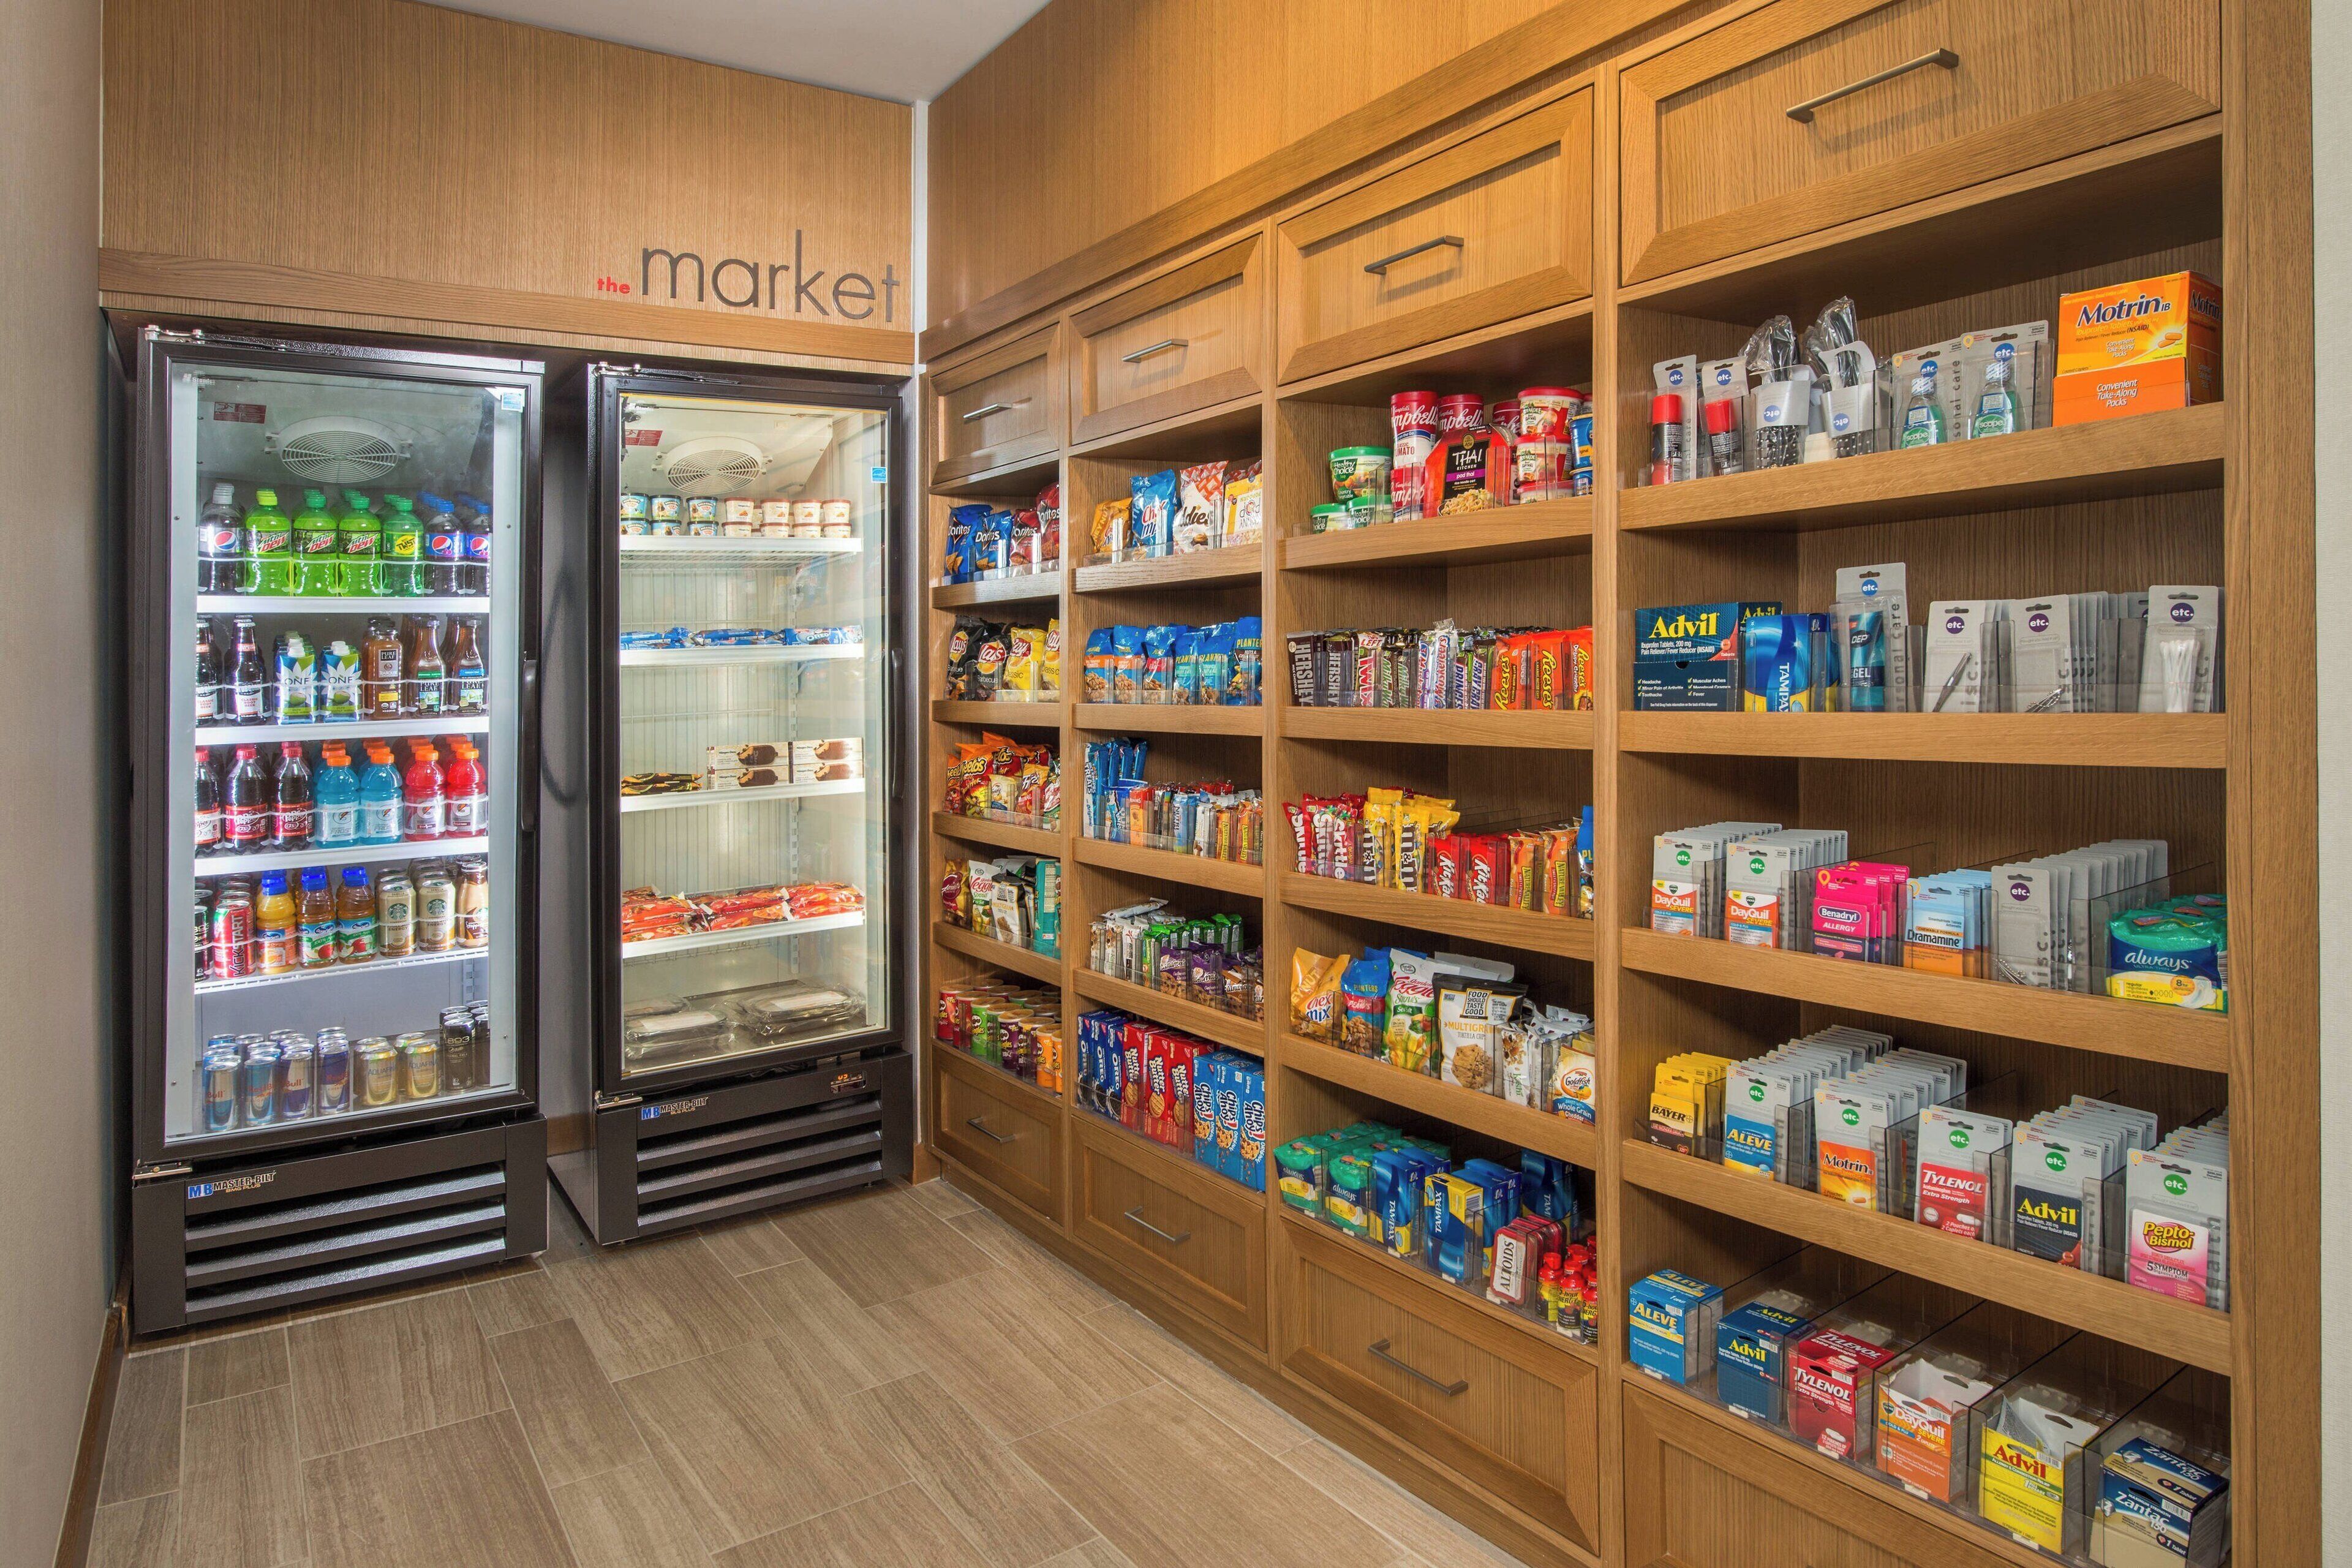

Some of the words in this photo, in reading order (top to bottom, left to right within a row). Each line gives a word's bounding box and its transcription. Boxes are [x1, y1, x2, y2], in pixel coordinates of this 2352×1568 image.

[597, 276, 630, 295] the
[642, 229, 900, 323] market
[2076, 293, 2162, 328] Motrin
[2161, 301, 2171, 312] IB
[2190, 290, 2221, 320] Motrin
[2097, 379, 2138, 393] Convenient
[2097, 388, 2138, 401] Take-Along
[2106, 398, 2128, 408] Packs
[1979, 418, 2003, 428] scope
[1905, 431, 1928, 442] scope
[1452, 448, 1482, 465] THAI
[1333, 466, 1355, 476] Choice
[1334, 460, 1356, 472] Healthy
[1457, 471, 1466, 480] pad
[2172, 609, 2194, 617] etc.
[1648, 612, 1717, 639] Advil
[1851, 635, 1869, 644] DEP
[1295, 643, 1314, 707] HERSHEY
[1359, 655, 1375, 707] TWIX
[1542, 649, 1558, 710] Reese's
[1852, 668, 1871, 678] GEL
[1333, 818, 1348, 880] Skittle
[1556, 862, 1566, 883] NATURE
[1555, 884, 1566, 907] VALLEY
[2011, 888, 2031, 896] etc.
[1654, 894, 1691, 909] DayQuil
[1731, 906, 1771, 921] DayQuil
[1822, 908, 1857, 922] Benadryl
[1746, 918, 1774, 927] SEVERE
[1823, 922, 1856, 932] ALLERGY
[1907, 929, 1960, 948] Dramamine
[2125, 949, 2190, 971] always
[1306, 993, 1332, 1010] Chex
[1149, 1060, 1161, 1095] Butter
[1155, 1056, 1165, 1093] Nutter
[1565, 1076, 1591, 1087] Goldfish
[285, 1079, 302, 1088] Bull
[207, 1090, 224, 1099] Bull
[1200, 1083, 1212, 1114] Chips
[1750, 1090, 1765, 1099] etc.
[1226, 1090, 1238, 1122] Chips
[1558, 1102, 1576, 1112] Whole
[1576, 1107, 1591, 1119] Grain
[1652, 1106, 1686, 1122] BAYER
[1251, 1101, 1265, 1134] Chips
[1842, 1113, 1860, 1121] etc.
[1727, 1129, 1773, 1151] ALEVE
[1950, 1134, 1969, 1144] etc.
[1823, 1154, 1868, 1175] Motrin
[2046, 1157, 2067, 1167] etc.
[212, 1174, 276, 1191] MASTER-BILT
[1283, 1167, 1305, 1181] always
[1923, 1170, 1983, 1194] TYLENOL
[1332, 1184, 1357, 1202] always
[2165, 1180, 2187, 1191] etc.
[1923, 1189, 1940, 1198] Extra
[1940, 1194, 1970, 1205] Strength
[1435, 1190, 1444, 1234] TAMPAX
[2017, 1197, 2077, 1226] Advil
[2143, 1222, 2195, 1240] Pepto-
[2149, 1235, 2193, 1250] Bismol
[1500, 1240, 1515, 1292] ALTOIDS
[2147, 1261, 2154, 1271] 5
[2154, 1262, 2188, 1278] SYMPTOM
[1634, 1303, 1678, 1329] ALEVE
[1728, 1340, 1766, 1363] Advil
[1818, 1332, 1882, 1359] TYLENOL
[1793, 1366, 1851, 1401] TYLENOL
[1811, 1392, 1835, 1406] Strength
[1894, 1407, 1945, 1439] DayQuil
[1918, 1429, 1946, 1446] SEVERE
[1993, 1445, 2046, 1479] Advil
[2143, 1446, 2207, 1477] Zantac
[2179, 1490, 2197, 1501] Tablet
[2115, 1491, 2169, 1526] Zantac
[2150, 1520, 2167, 1533] 150
[2172, 1544, 2186, 1555] Tablet
